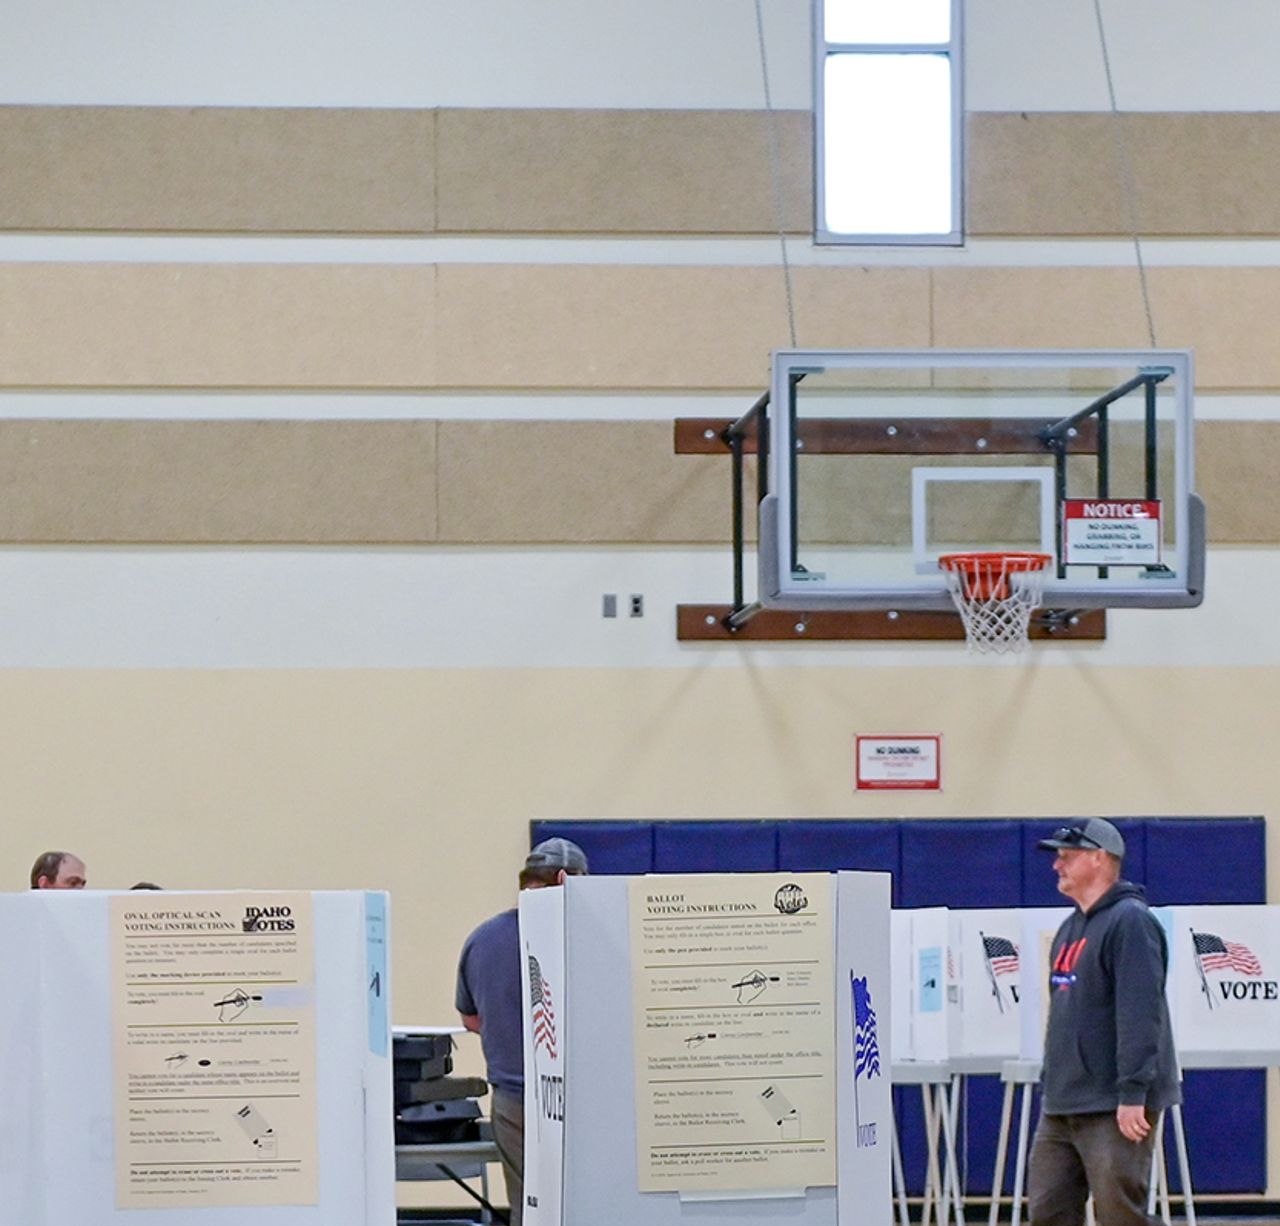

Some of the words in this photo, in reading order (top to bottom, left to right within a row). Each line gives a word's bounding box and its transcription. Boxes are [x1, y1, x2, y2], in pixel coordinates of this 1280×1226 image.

[1083, 503, 1142, 518] NOTICE
[646, 894, 685, 903] BALLOT
[244, 906, 292, 918] IDAHO
[647, 905, 685, 914] VOTING
[686, 903, 757, 913] INSTRUCTIONS
[124, 911, 150, 921] OVAL
[152, 911, 194, 920] OPTICAL
[197, 910, 221, 919] SCAN
[125, 922, 162, 931] VOTING
[164, 921, 236, 931] INSTRUCTIONS
[1219, 981, 1279, 1000] VOTE
